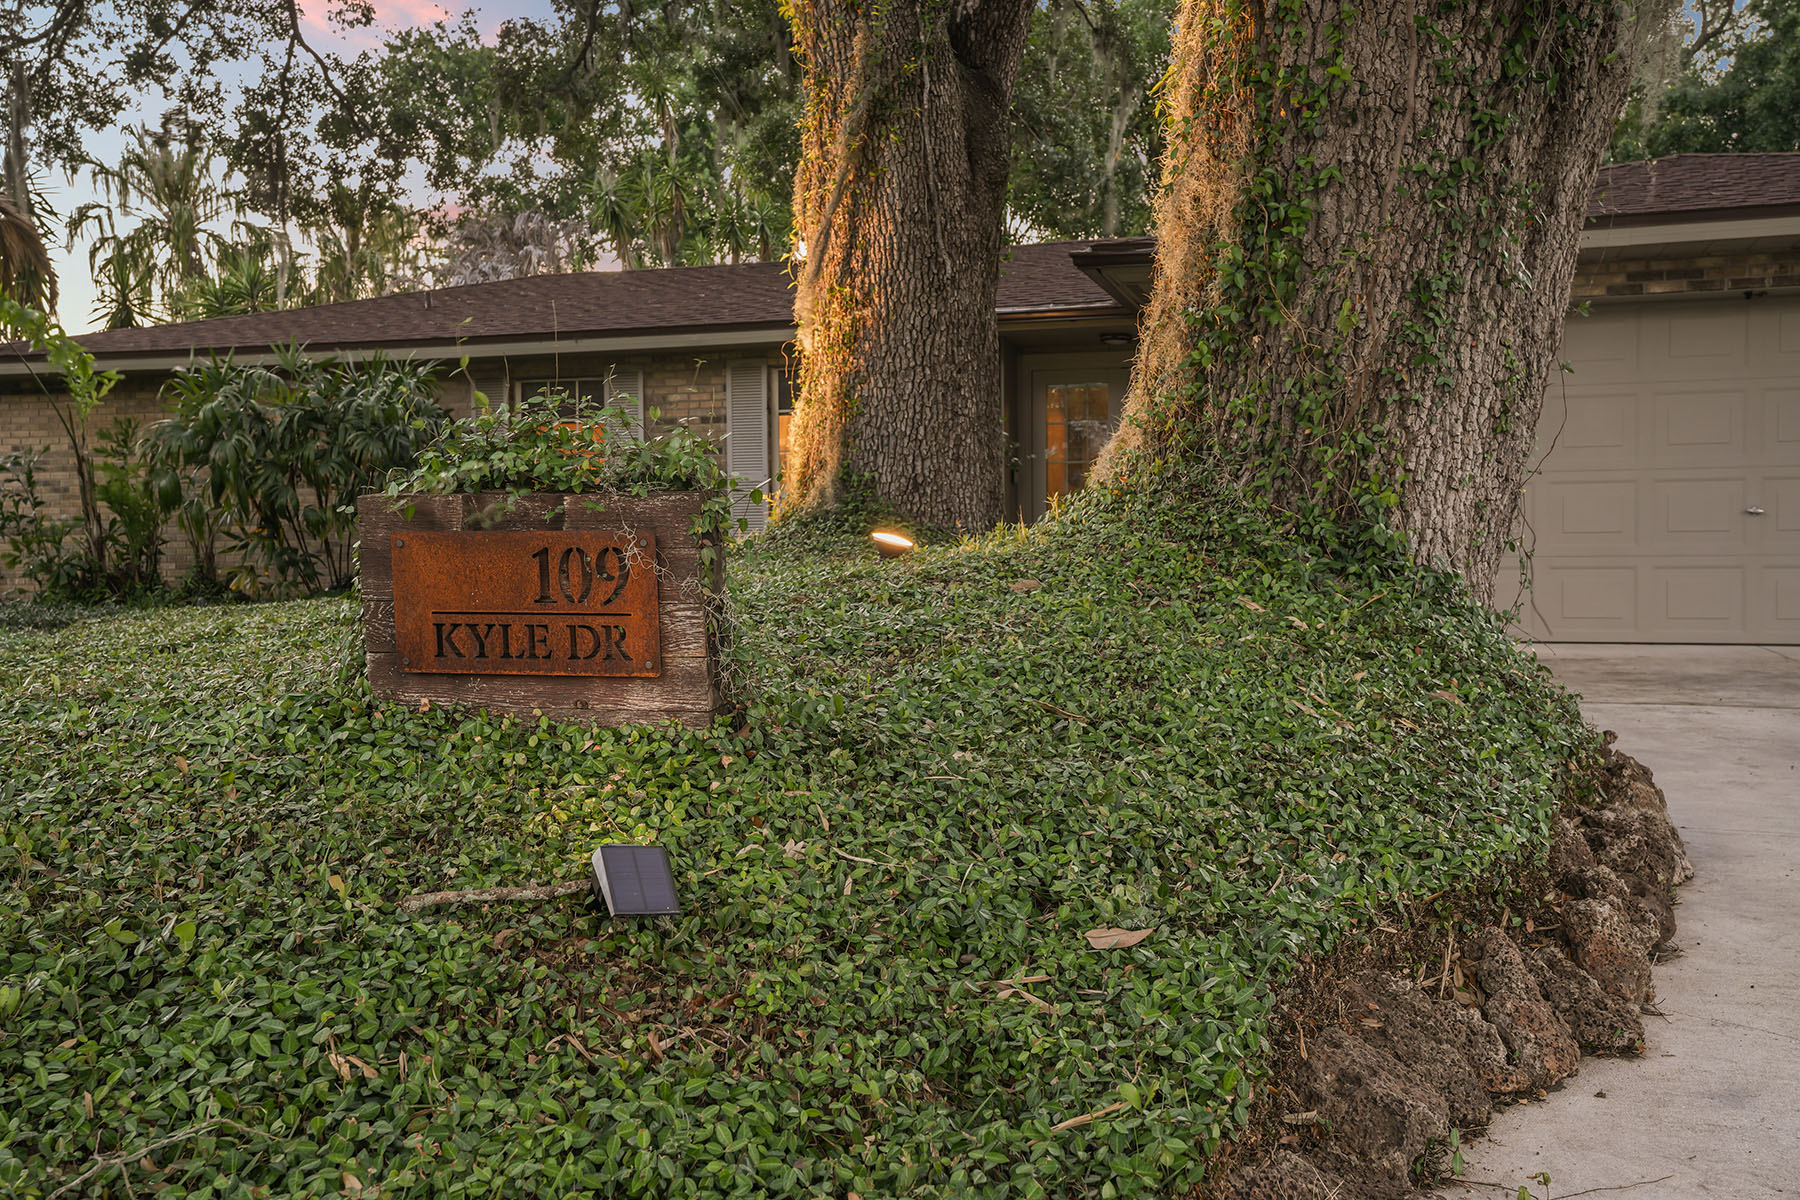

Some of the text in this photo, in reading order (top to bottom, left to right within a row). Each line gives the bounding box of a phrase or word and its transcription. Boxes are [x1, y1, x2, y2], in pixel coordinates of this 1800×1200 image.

[531, 546, 630, 606] 109
[432, 623, 633, 661] KYLE DR
